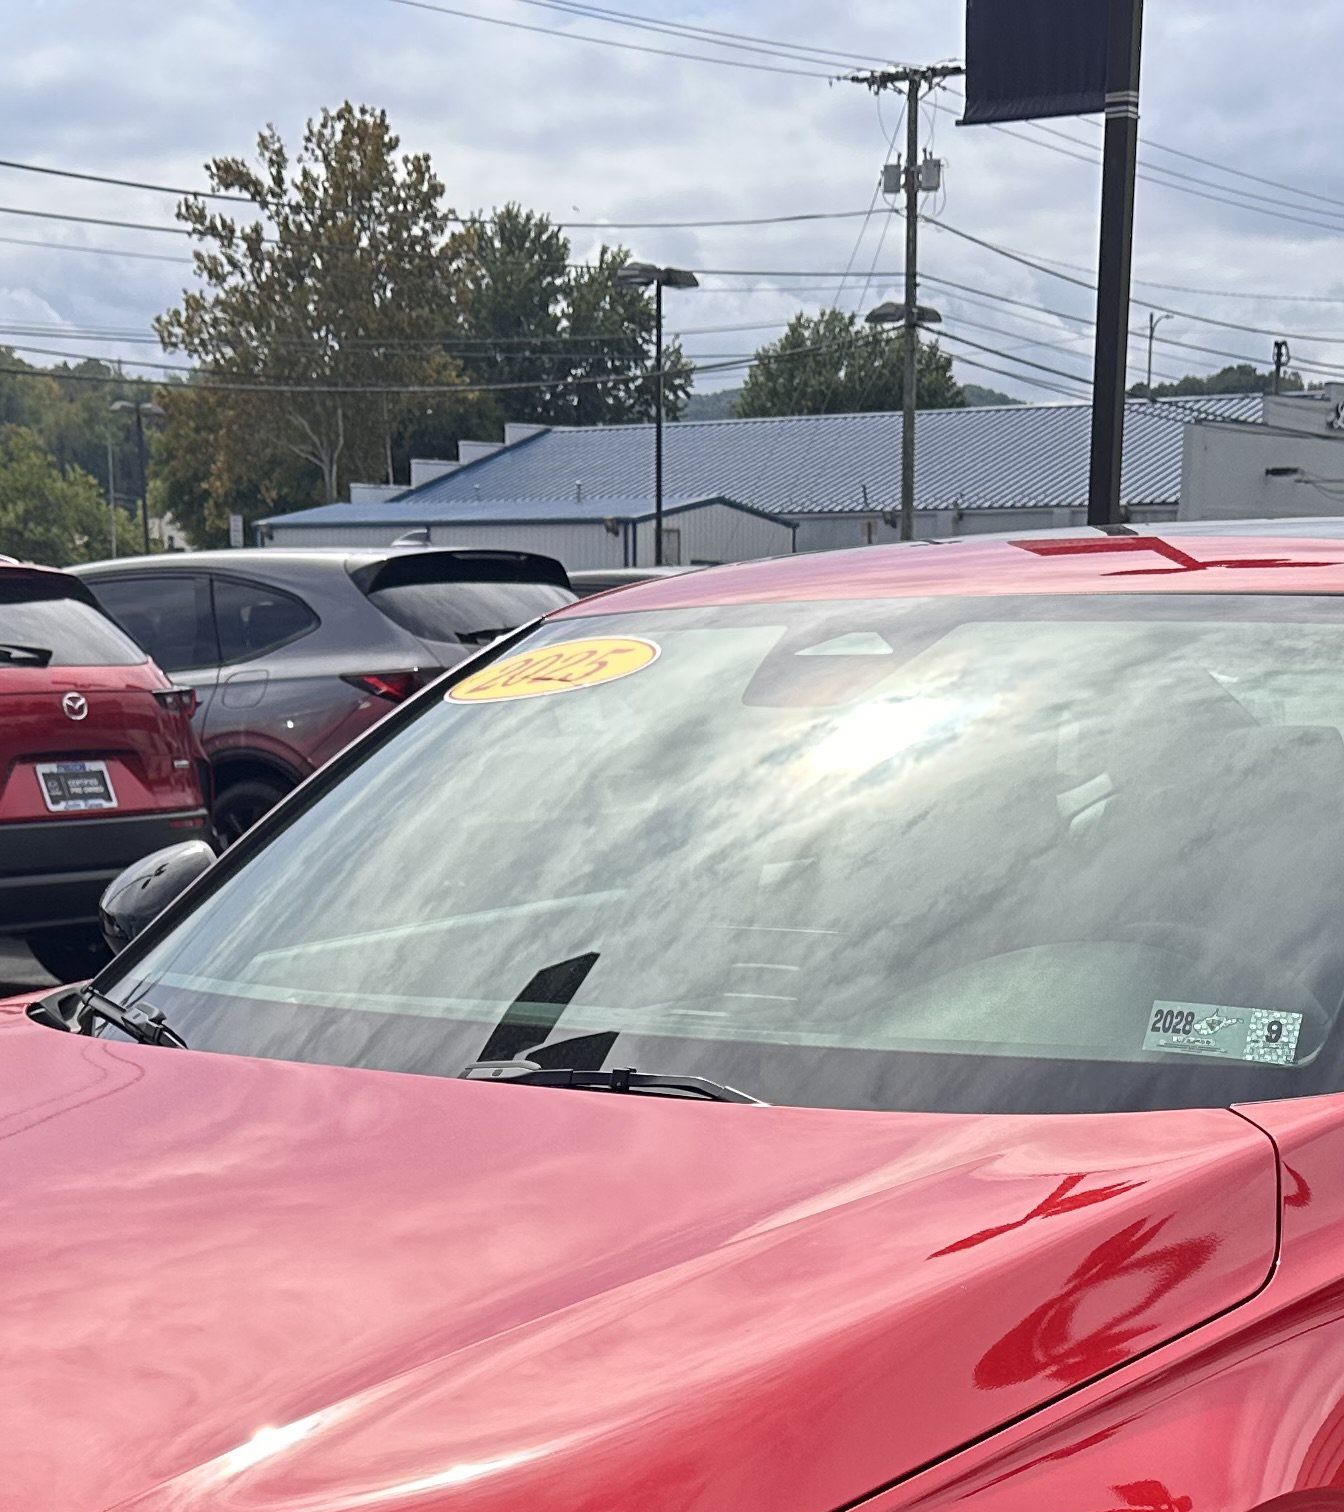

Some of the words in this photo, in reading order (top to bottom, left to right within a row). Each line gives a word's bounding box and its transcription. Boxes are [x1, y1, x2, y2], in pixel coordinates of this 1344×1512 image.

[464, 648, 635, 694] 2025
[1150, 1008, 1196, 1036] 2028
[1264, 1020, 1283, 1044] 9
